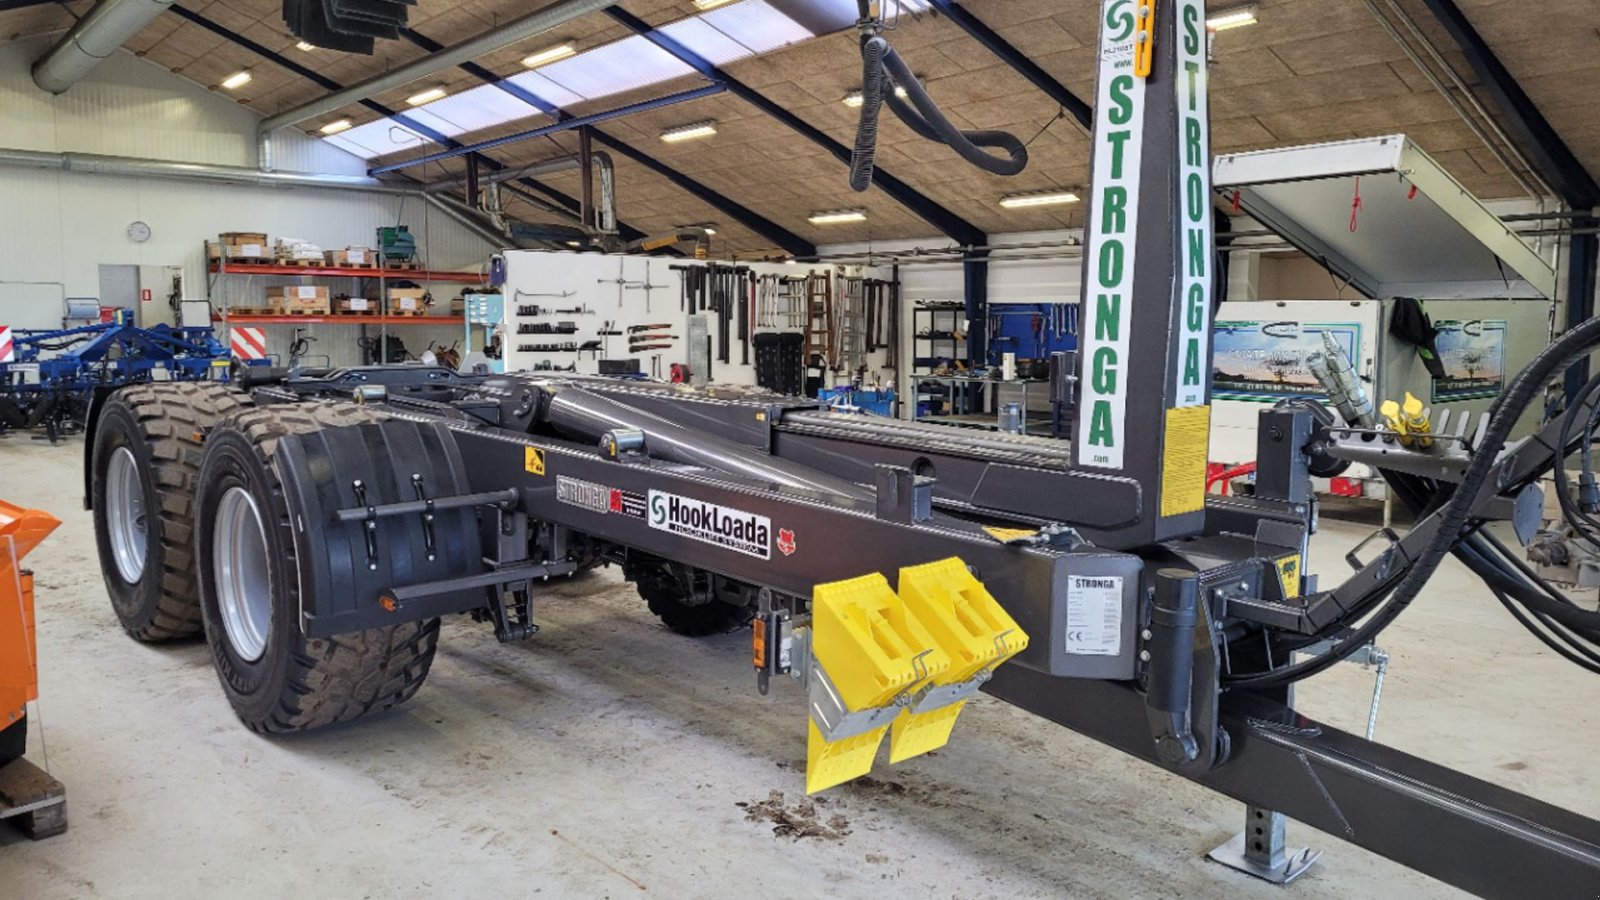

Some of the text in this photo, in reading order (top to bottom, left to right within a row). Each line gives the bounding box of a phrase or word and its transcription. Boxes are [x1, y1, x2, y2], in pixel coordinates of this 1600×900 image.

[1183, 4, 1205, 386] STRONGA
[1088, 74, 1133, 448] STRONGA
[1091, 454, 1110, 464] .com
[558, 478, 607, 511] STRONGA
[669, 496, 768, 546] HookLoada
[1075, 578, 1115, 589] STRONGA
